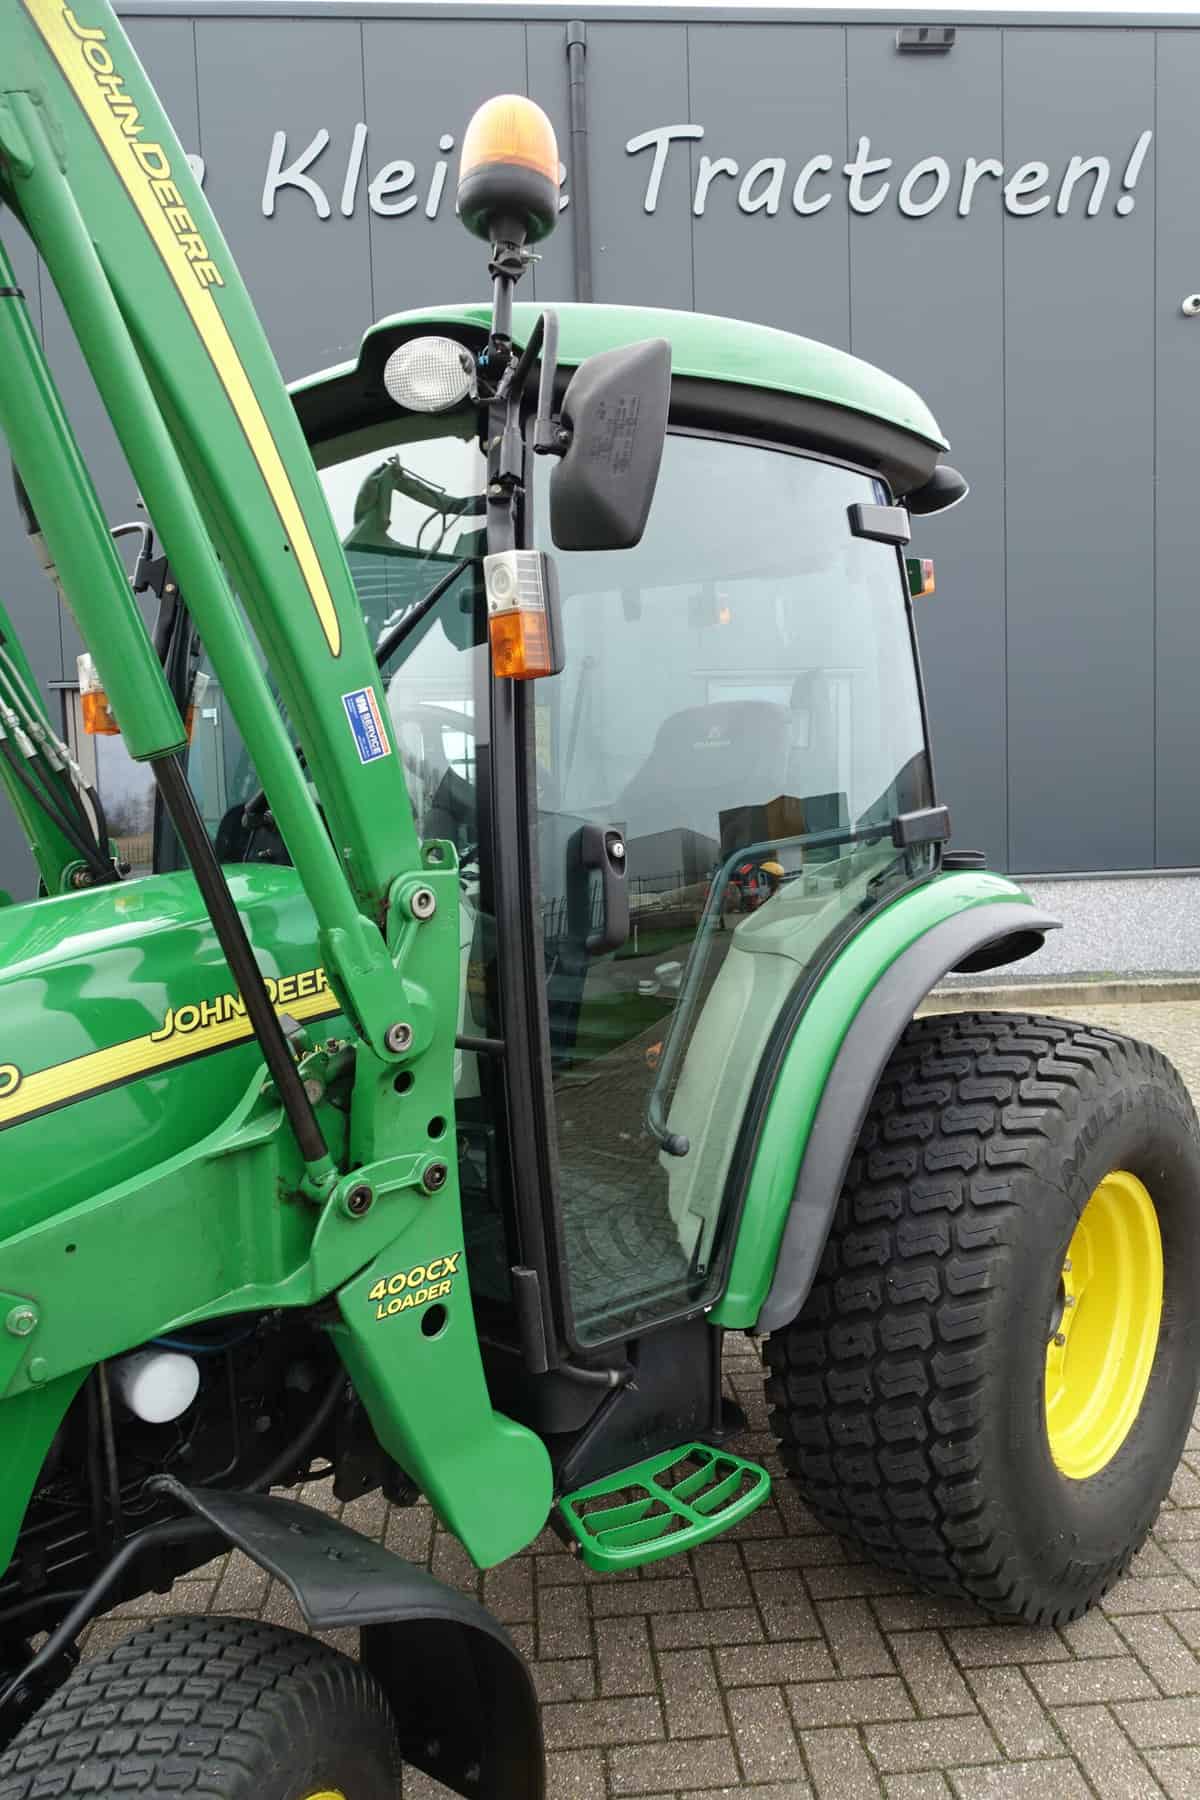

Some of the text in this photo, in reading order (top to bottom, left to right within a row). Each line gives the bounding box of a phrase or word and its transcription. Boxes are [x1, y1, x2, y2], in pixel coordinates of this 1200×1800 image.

[63, 8, 226, 289] JOHN DEERE
[262, 122, 1153, 219] Klei Tractoren!
[362, 713, 382, 754] SERVICE
[150, 967, 331, 1042] JOHN DEER
[368, 1251, 462, 1302] 400CX
[376, 1279, 453, 1321] LOADER
